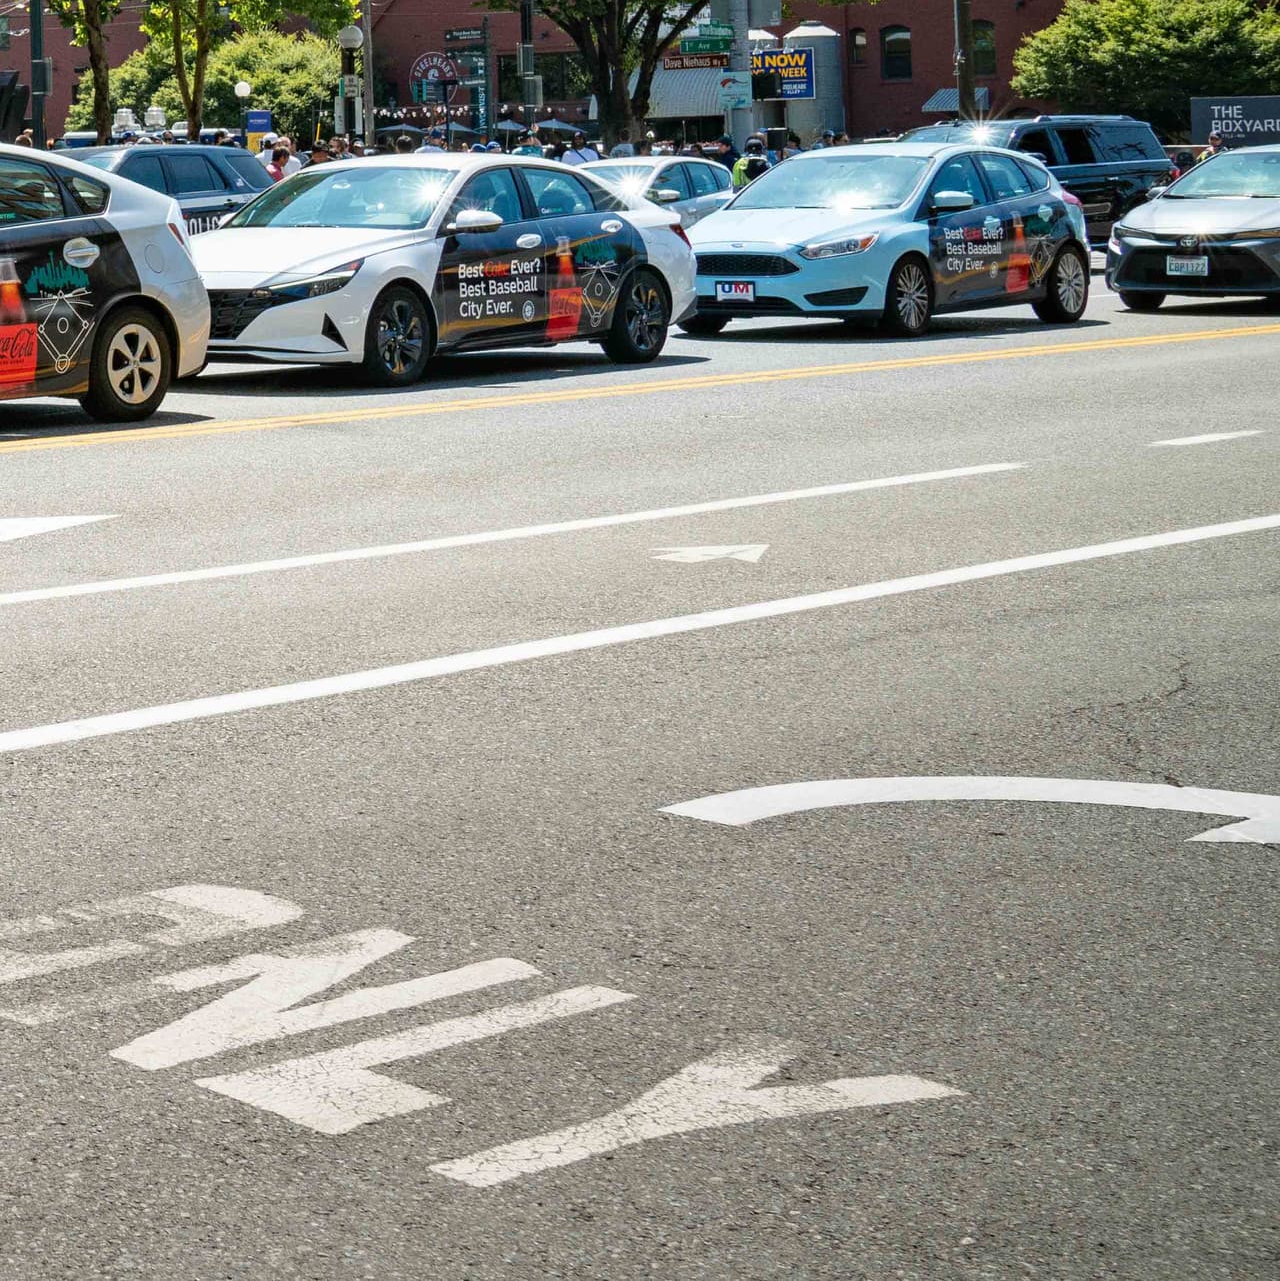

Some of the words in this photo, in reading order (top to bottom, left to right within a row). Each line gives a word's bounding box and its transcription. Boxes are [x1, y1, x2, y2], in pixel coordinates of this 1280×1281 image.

[665, 58, 682, 69] Dave
[683, 56, 711, 68] Niehaus
[765, 52, 806, 67] NOW
[780, 67, 807, 78] WEEK
[1210, 105, 1243, 119] THE
[943, 227, 963, 240] Best
[982, 227, 1003, 240] Ever?
[946, 242, 966, 255] Best
[967, 241, 1002, 255] Baseball
[458, 262, 484, 279] Best
[510, 258, 541, 275] Ever?
[947, 258, 964, 273] City
[965, 258, 985, 271] Ever.
[459, 280, 486, 297] Best
[489, 276, 538, 295] Baseball
[721, 281, 750, 295] UM
[459, 300, 484, 319] City
[486, 299, 514, 315] Ever.
